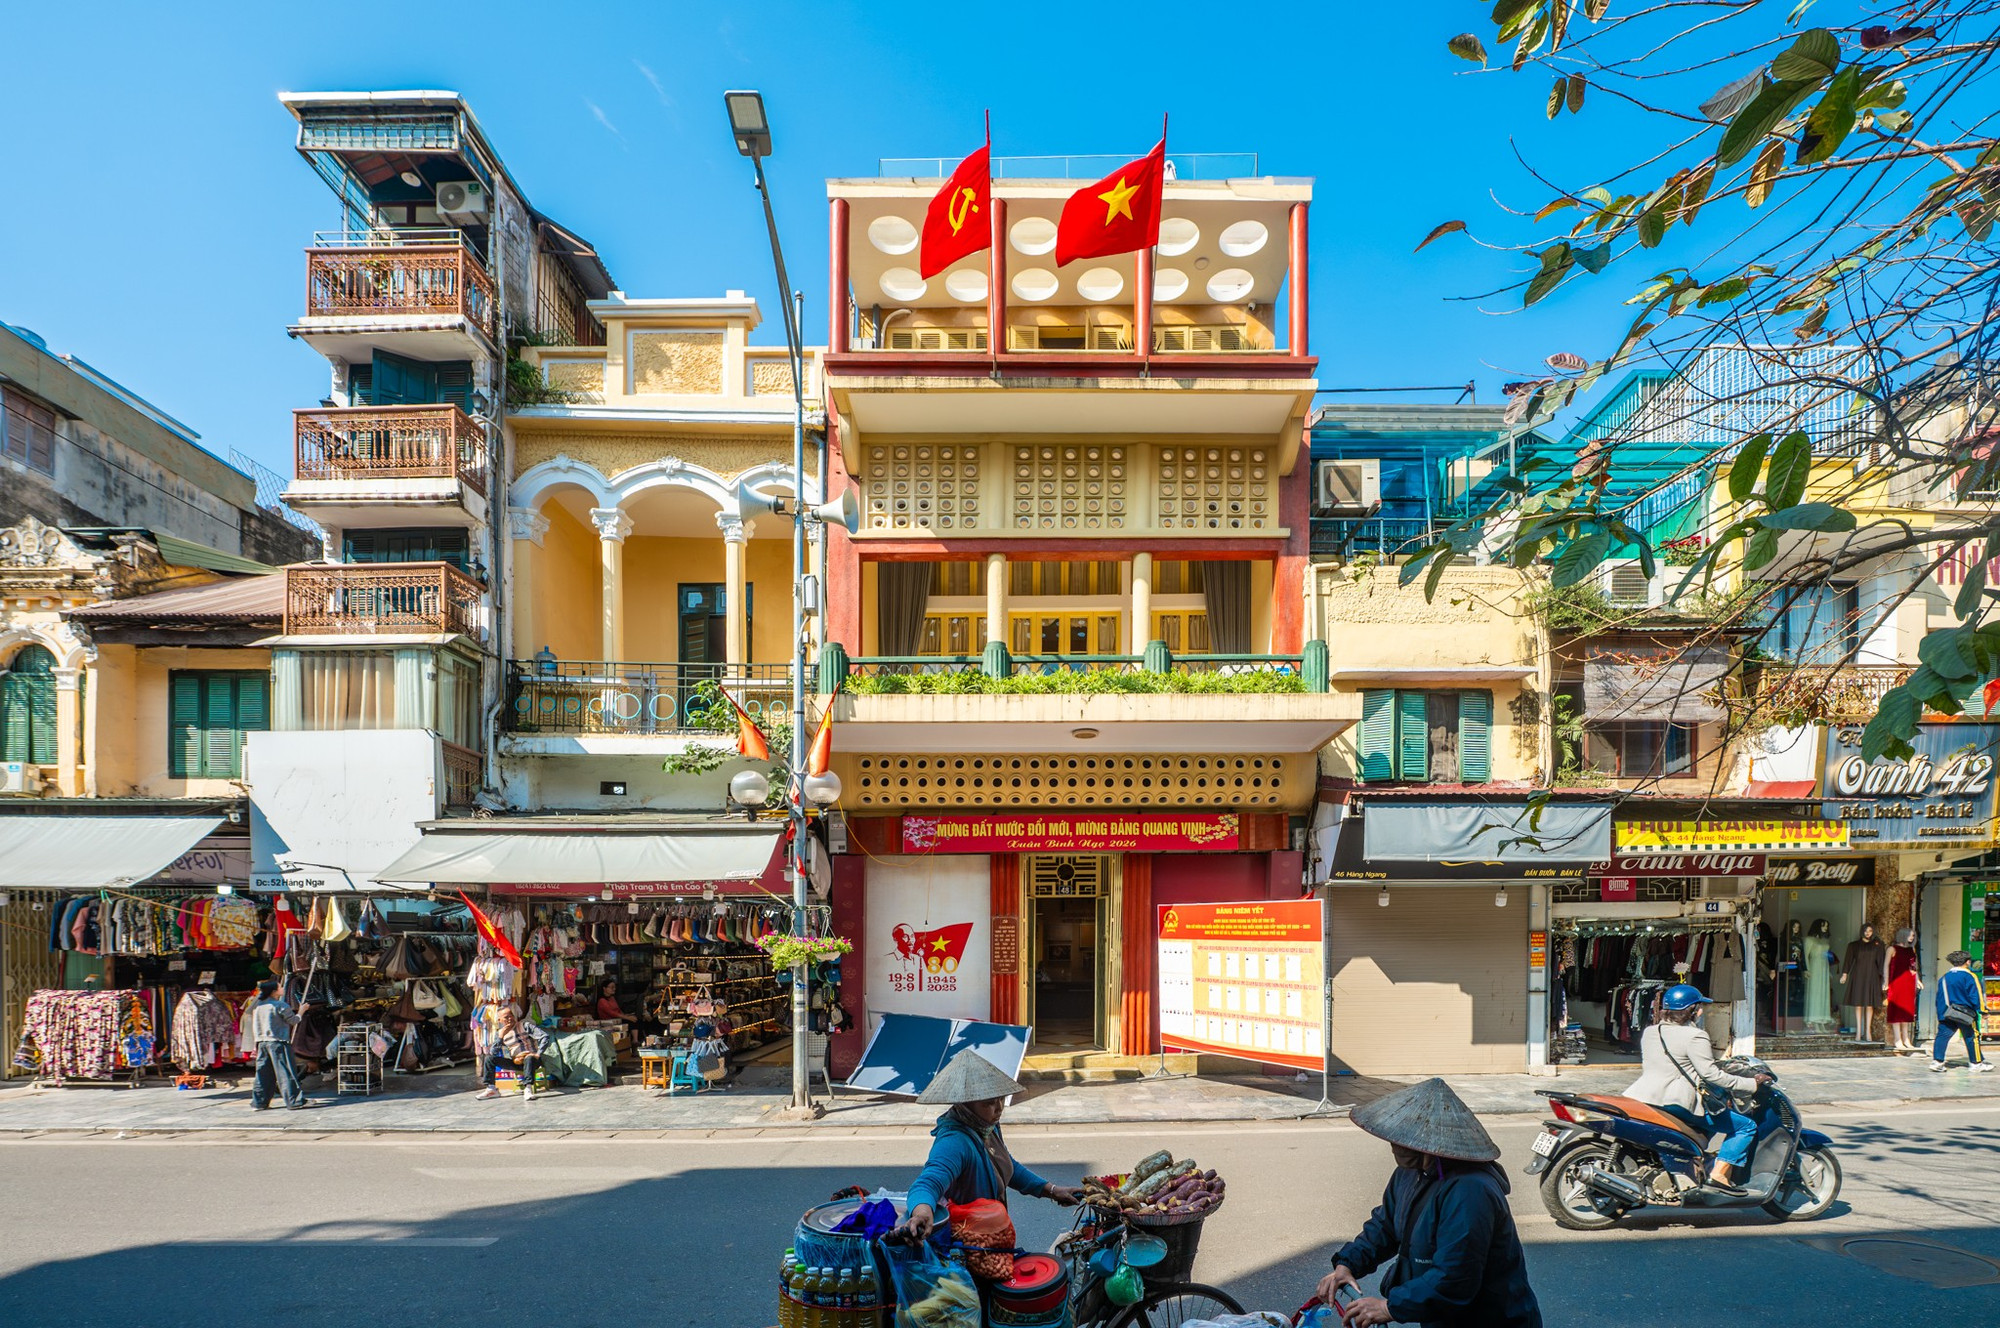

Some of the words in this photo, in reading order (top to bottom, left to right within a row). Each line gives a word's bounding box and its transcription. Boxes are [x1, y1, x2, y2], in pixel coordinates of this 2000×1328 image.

[1838, 754, 1933, 795] Oanh
[1940, 753, 1994, 795] 42
[937, 821, 969, 837] MỪNG
[972, 819, 993, 837] ĐẤT
[995, 820, 1025, 837] NƯỚC
[1027, 818, 1046, 836] ĐỔI
[1049, 820, 1073, 837] MỚI,
[1075, 820, 1108, 836] MỪNG
[1110, 818, 1140, 836] ĐẢNG
[1142, 822, 1178, 837] QUANG
[1109, 839, 1137, 848] 2026
[1365, 871, 1387, 879] Ngang
[1806, 861, 1859, 883] Belly
[270, 879, 281, 887] 52
[630, 883, 654, 892] Trang
[671, 883, 684, 891] Em
[1707, 903, 1717, 911] 44
[927, 956, 958, 974] 80
[927, 976, 957, 984] 1945
[927, 984, 957, 992] 2025
